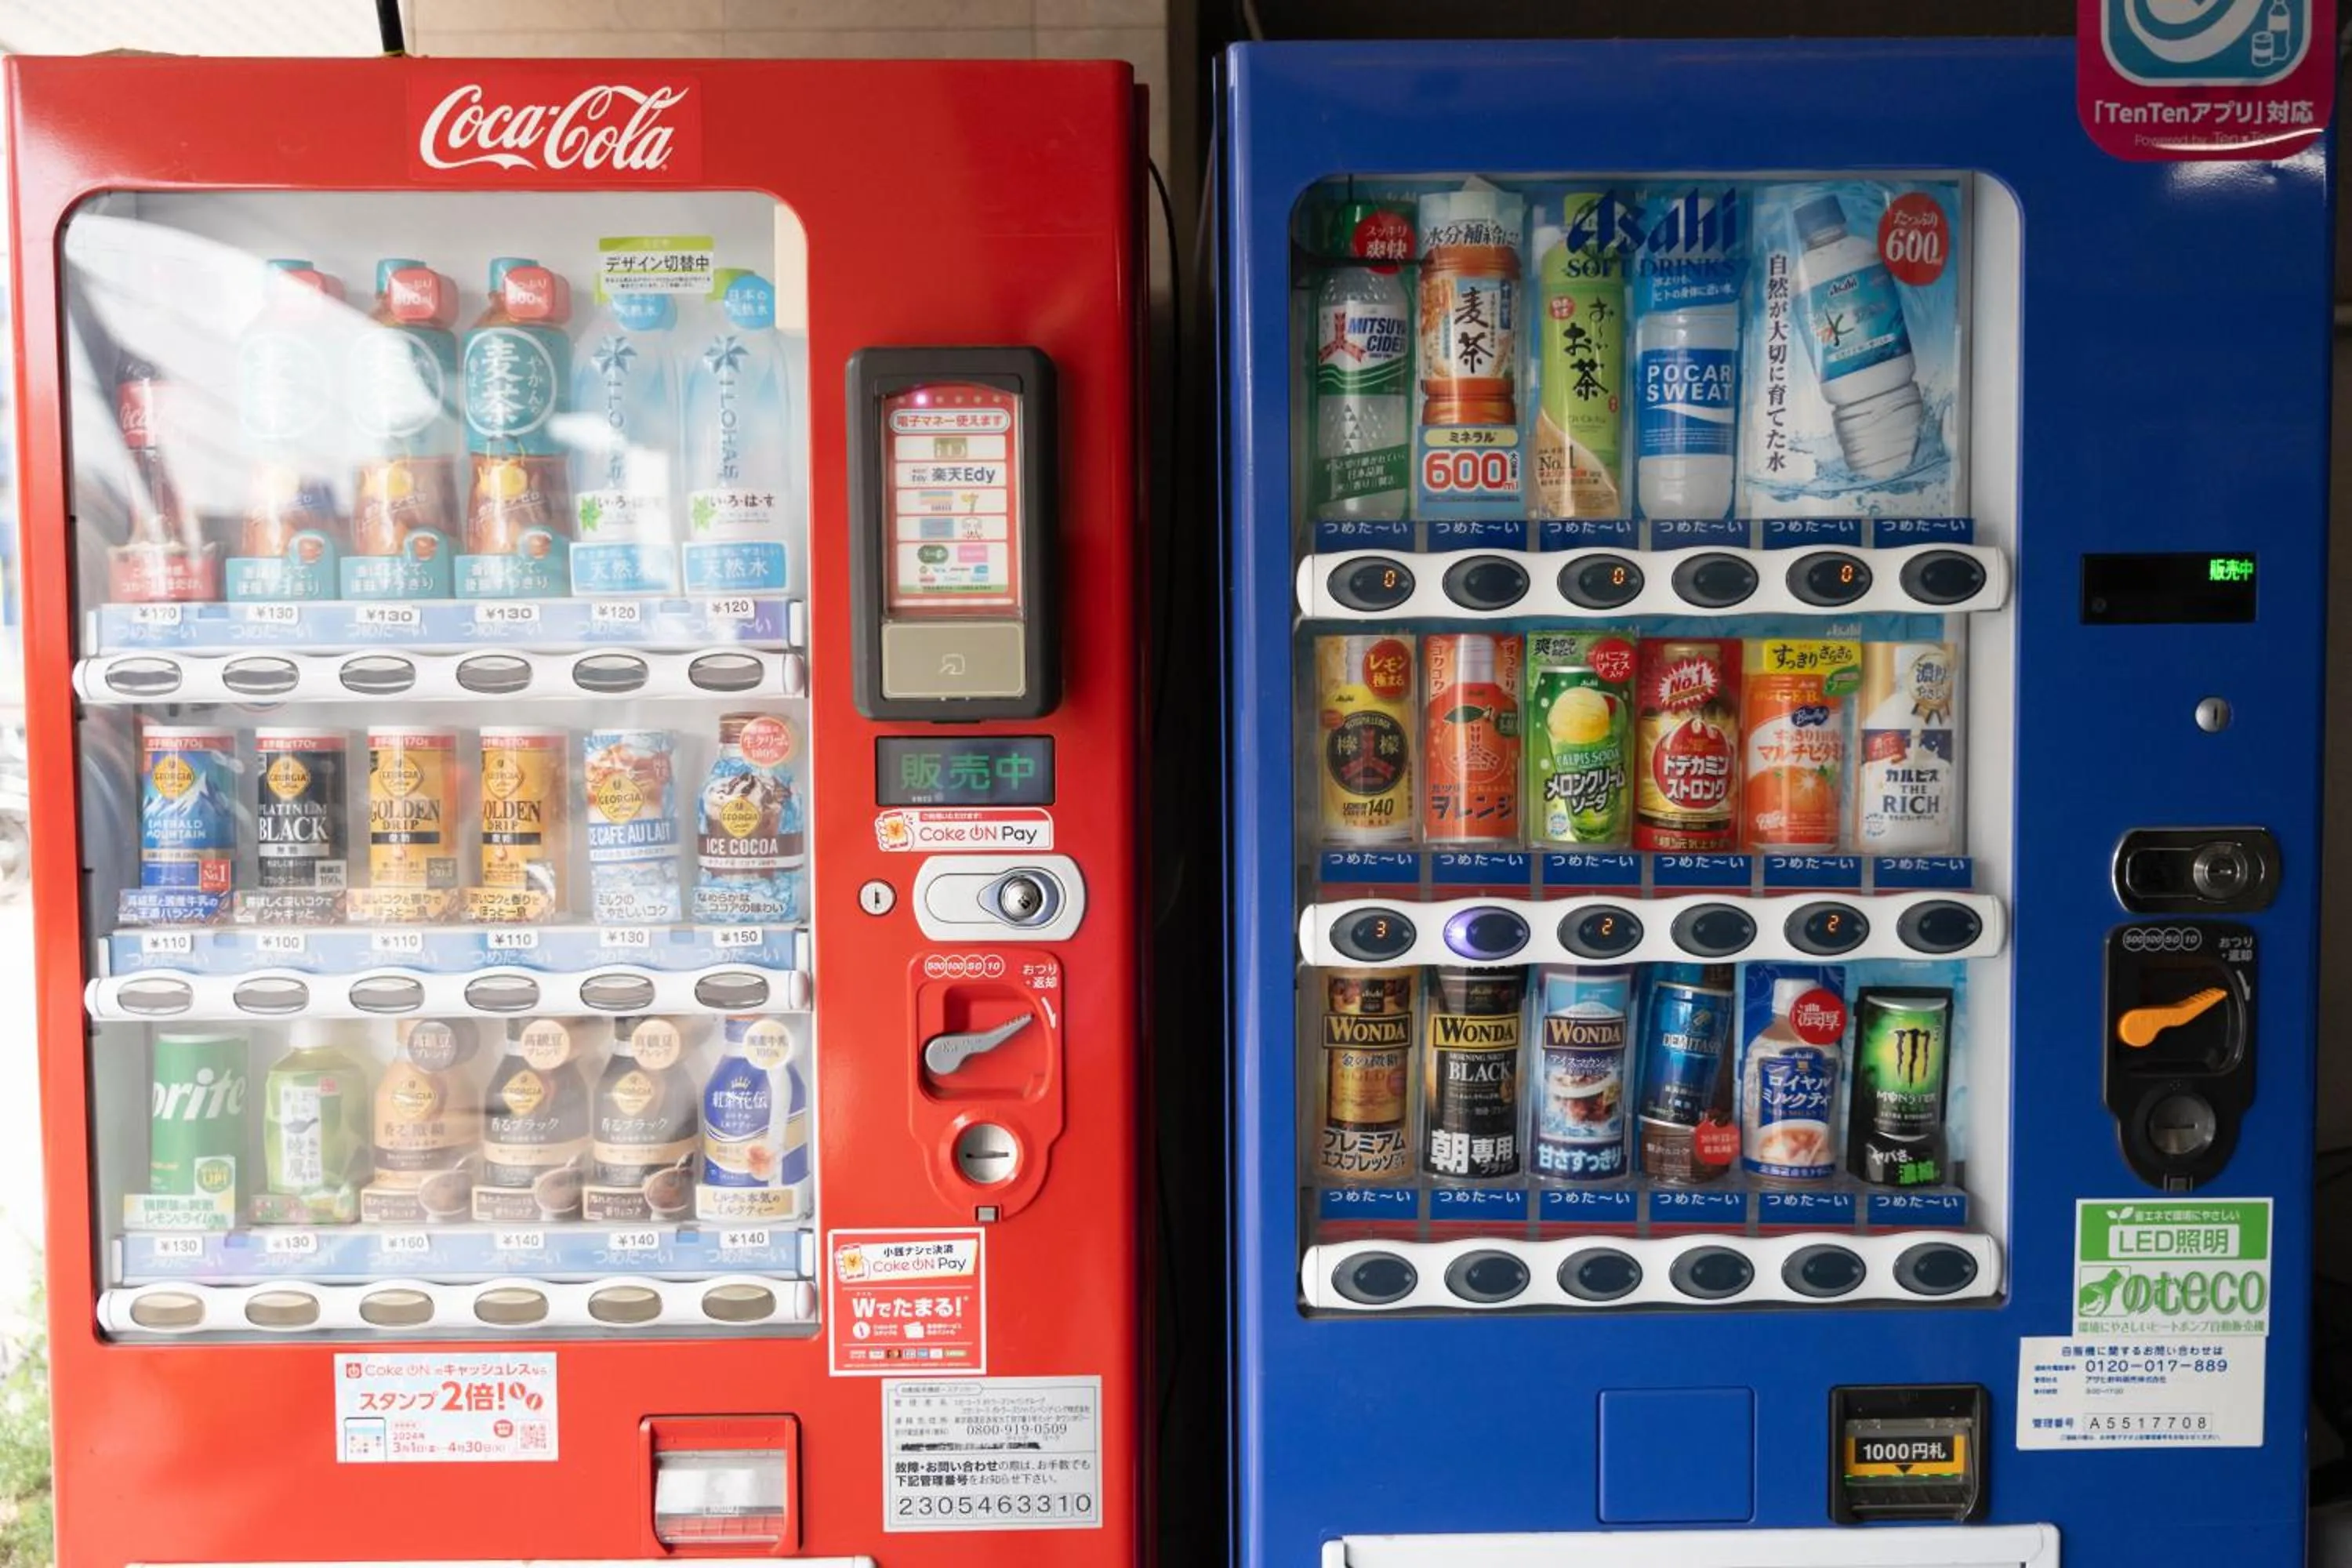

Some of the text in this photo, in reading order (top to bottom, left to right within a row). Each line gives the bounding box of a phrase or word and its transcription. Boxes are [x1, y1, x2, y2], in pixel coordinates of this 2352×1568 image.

[2094, 100, 2314, 124] 「TenTenアプリ」対応
[419, 84, 690, 170] Coca-Cola
[1566, 187, 1737, 254] Asahi
[1893, 209, 1939, 227] たっぷり
[1425, 224, 1519, 247] 水分補給に
[1367, 240, 1408, 260] 爽快
[605, 254, 710, 273] デザイン切替中
[1454, 287, 1494, 374] 麦茶
[1563, 322, 1609, 401] お茶
[1766, 254, 1789, 472] 自然が大切に育てた水
[481, 337, 525, 425] 麦茶
[1647, 383, 1733, 402] SWEAT
[896, 415, 1004, 427] 電子マネー使えます
[1449, 432, 1497, 444] ミネラル
[932, 466, 996, 483] 楽天Edy
[703, 559, 769, 580] 天然水
[1383, 570, 1396, 587] 0
[1613, 568, 1625, 584] 0
[1841, 565, 1853, 583] 0
[2209, 559, 2254, 581] 販売中
[257, 607, 293, 619] ¥130
[367, 609, 413, 622] ¥130
[486, 608, 532, 620] ¥130
[599, 605, 636, 620] ¥120
[712, 601, 750, 615] ¥120
[1370, 655, 1406, 672] レモン
[1773, 644, 1817, 669] すっきり
[1670, 668, 1706, 693] No.1
[901, 753, 1035, 791] 販売中
[1663, 755, 1730, 775] ドデカミン
[1544, 769, 1625, 800] メロンクリーム
[1885, 769, 1940, 782] カルピス
[1666, 779, 1726, 800] ストロング
[1901, 785, 1928, 794] THE
[598, 794, 642, 805] GEORGIA
[1367, 797, 1395, 817] 140
[1571, 793, 1607, 815] ソーダ
[1882, 795, 1940, 815] RICH
[371, 799, 441, 823] GOLDEN
[483, 800, 542, 823] OLDEN
[722, 812, 759, 822] GEORGIA
[259, 816, 328, 842] BLACK
[383, 820, 419, 830] DRIP
[597, 823, 671, 845] CAFE AU LAIT
[920, 826, 966, 842] Coke
[1002, 826, 1037, 845] Pay
[706, 837, 779, 855] ICE COCOA
[1376, 920, 1387, 938] 3
[1602, 917, 1613, 935] 2
[1828, 914, 1839, 933] 2
[151, 935, 187, 948] ¥110
[262, 935, 299, 949] ¥100
[381, 935, 418, 947] ¥110
[495, 933, 532, 946] ¥110
[608, 931, 644, 943] ¥130
[720, 931, 758, 943] ¥150
[2219, 937, 2253, 949] おつり
[1022, 964, 1057, 975] おつり
[1331, 1016, 1406, 1043] WONDA
[1440, 1018, 1514, 1044] WONDA
[1549, 1018, 1621, 1044] WONDA
[1449, 1061, 1513, 1082] BLACK
[1769, 1075, 1831, 1088] ロイヤル
[713, 1091, 768, 1109] 紅茶花伝
[1876, 1090, 1936, 1105] MONSTER
[491, 1117, 560, 1131] 香るブラック
[601, 1117, 668, 1131] 香るブラック
[1323, 1130, 1406, 1153] プレミアム
[1431, 1130, 1513, 1174] 朝専用
[1538, 1142, 1622, 1172] 甘さすっきり
[2135, 1210, 2241, 1222] 省エネで環境にやさしい
[161, 1240, 198, 1253] ¥130
[273, 1236, 309, 1248] ¥130
[388, 1236, 424, 1248] ¥160
[503, 1234, 539, 1247] ¥140
[618, 1234, 655, 1247] ¥140
[728, 1232, 765, 1244] ¥140
[2119, 1228, 2229, 1254] LED照明
[873, 1261, 910, 1272] Coke
[938, 1257, 967, 1272] Pay
[2078, 1320, 2265, 1334] 環境にやさしいヒートポンプ自動販売機
[2062, 1345, 2223, 1357] 自販機に関するお問い合わせは
[365, 1365, 403, 1376] Coke
[2085, 1359, 2227, 1373] 0120-017-889
[967, 1423, 1067, 1436] 0800-919-0509
[2032, 1417, 2207, 1430] 管理番号 A5517708
[1863, 1442, 1947, 1461] 1000円札
[895, 1473, 1058, 1487] 下記管理番号をお知らせ下さい。
[898, 1494, 1091, 1516] 2305463310
